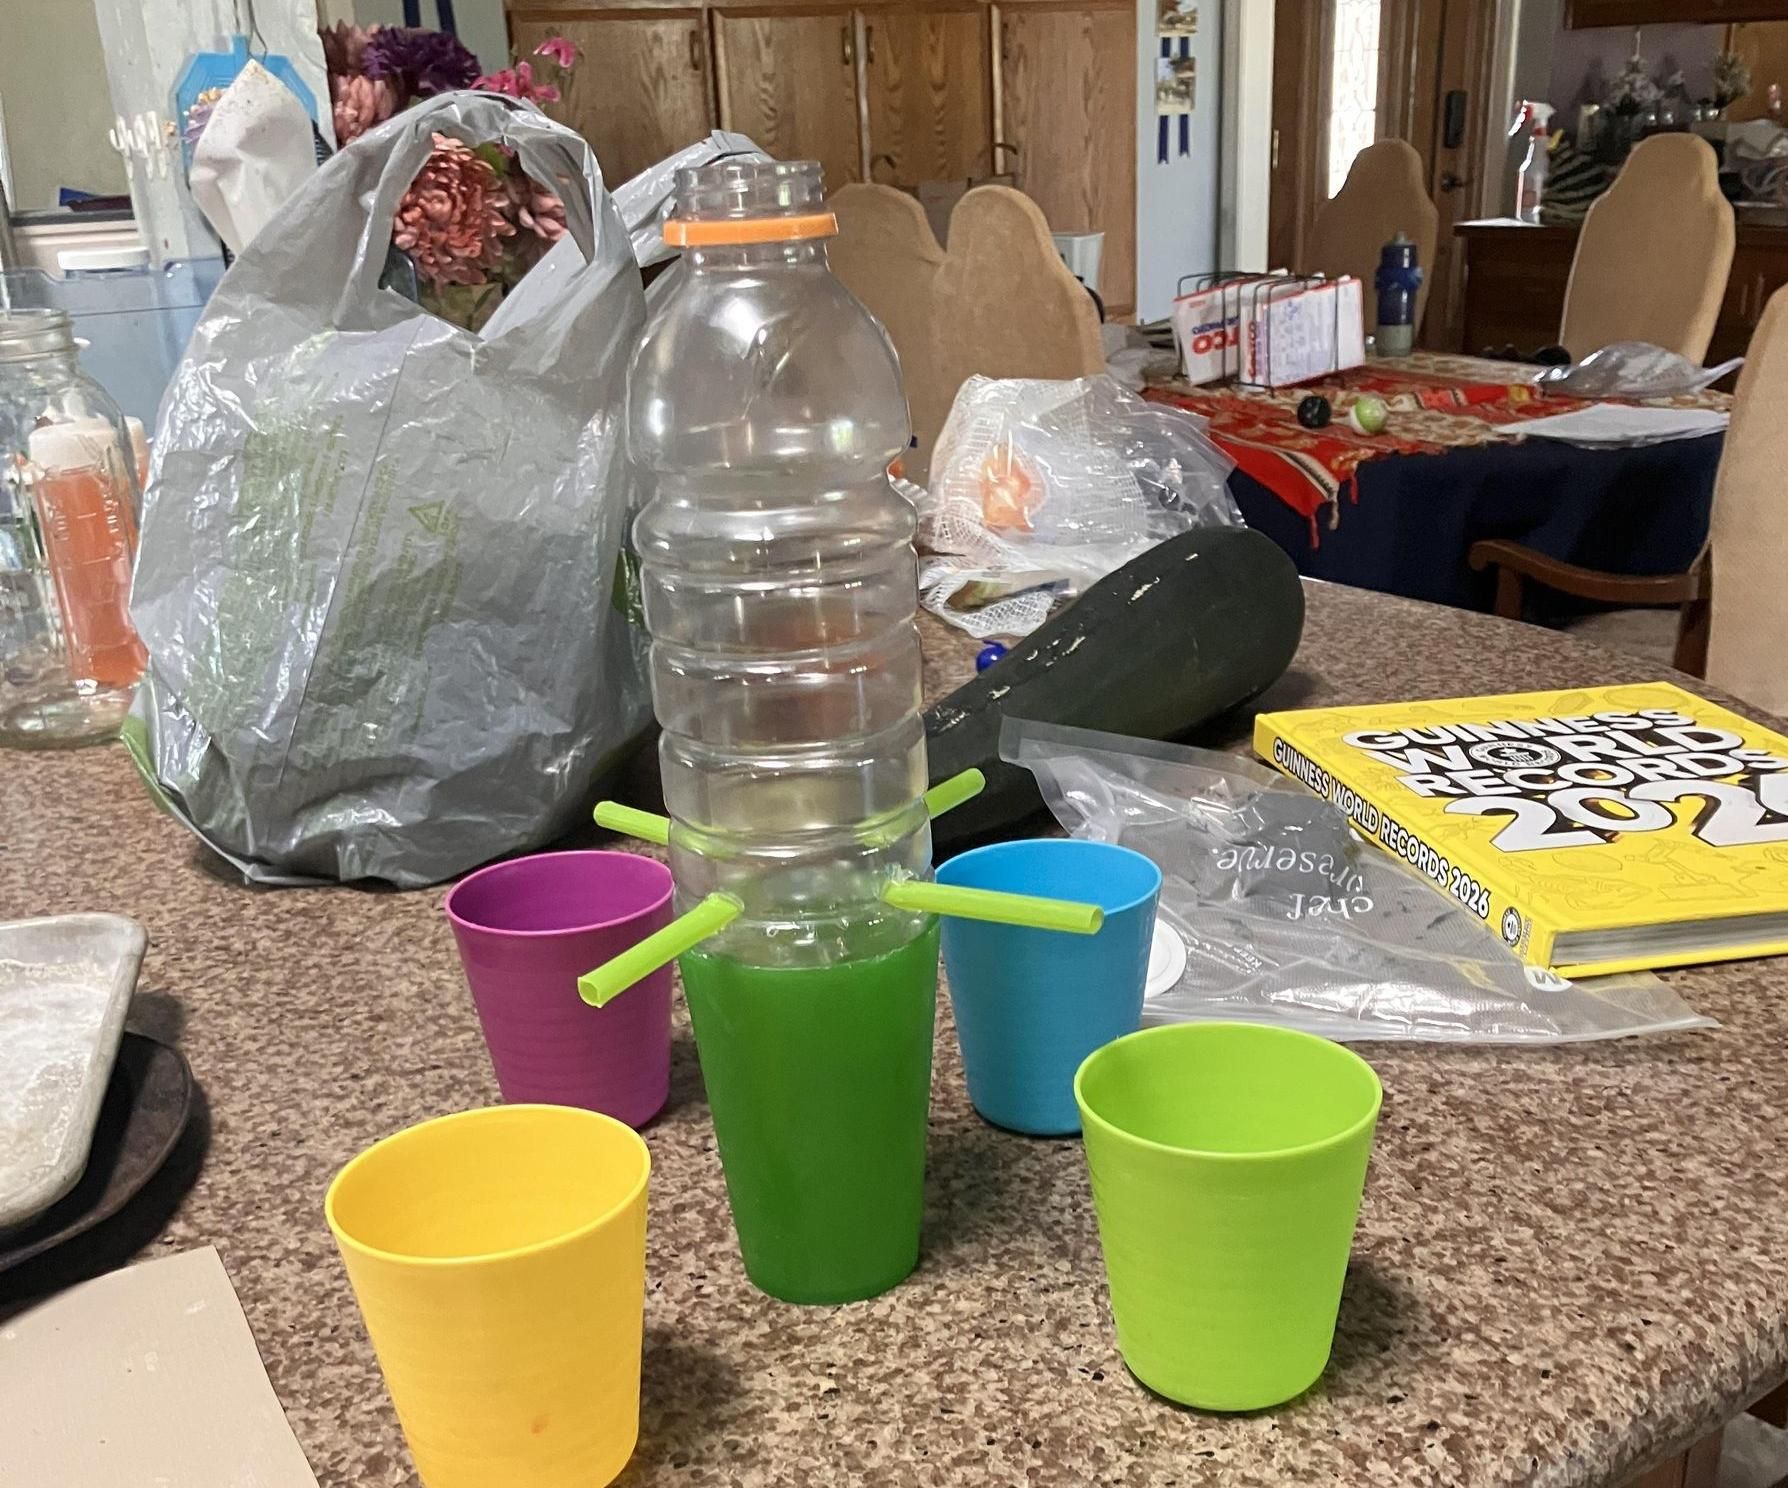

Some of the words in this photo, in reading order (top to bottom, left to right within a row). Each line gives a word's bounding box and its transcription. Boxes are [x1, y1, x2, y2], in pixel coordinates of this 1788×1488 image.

[1342, 708, 1696, 750] GUINNESS
[1394, 749, 1788, 797] RECORDS
[1273, 736, 1330, 798] GUINNESS
[1331, 775, 1379, 834] WORLD
[1379, 812, 1449, 888] RECORDS
[1449, 866, 1491, 919] 2026
[1286, 893, 1374, 921] chef
